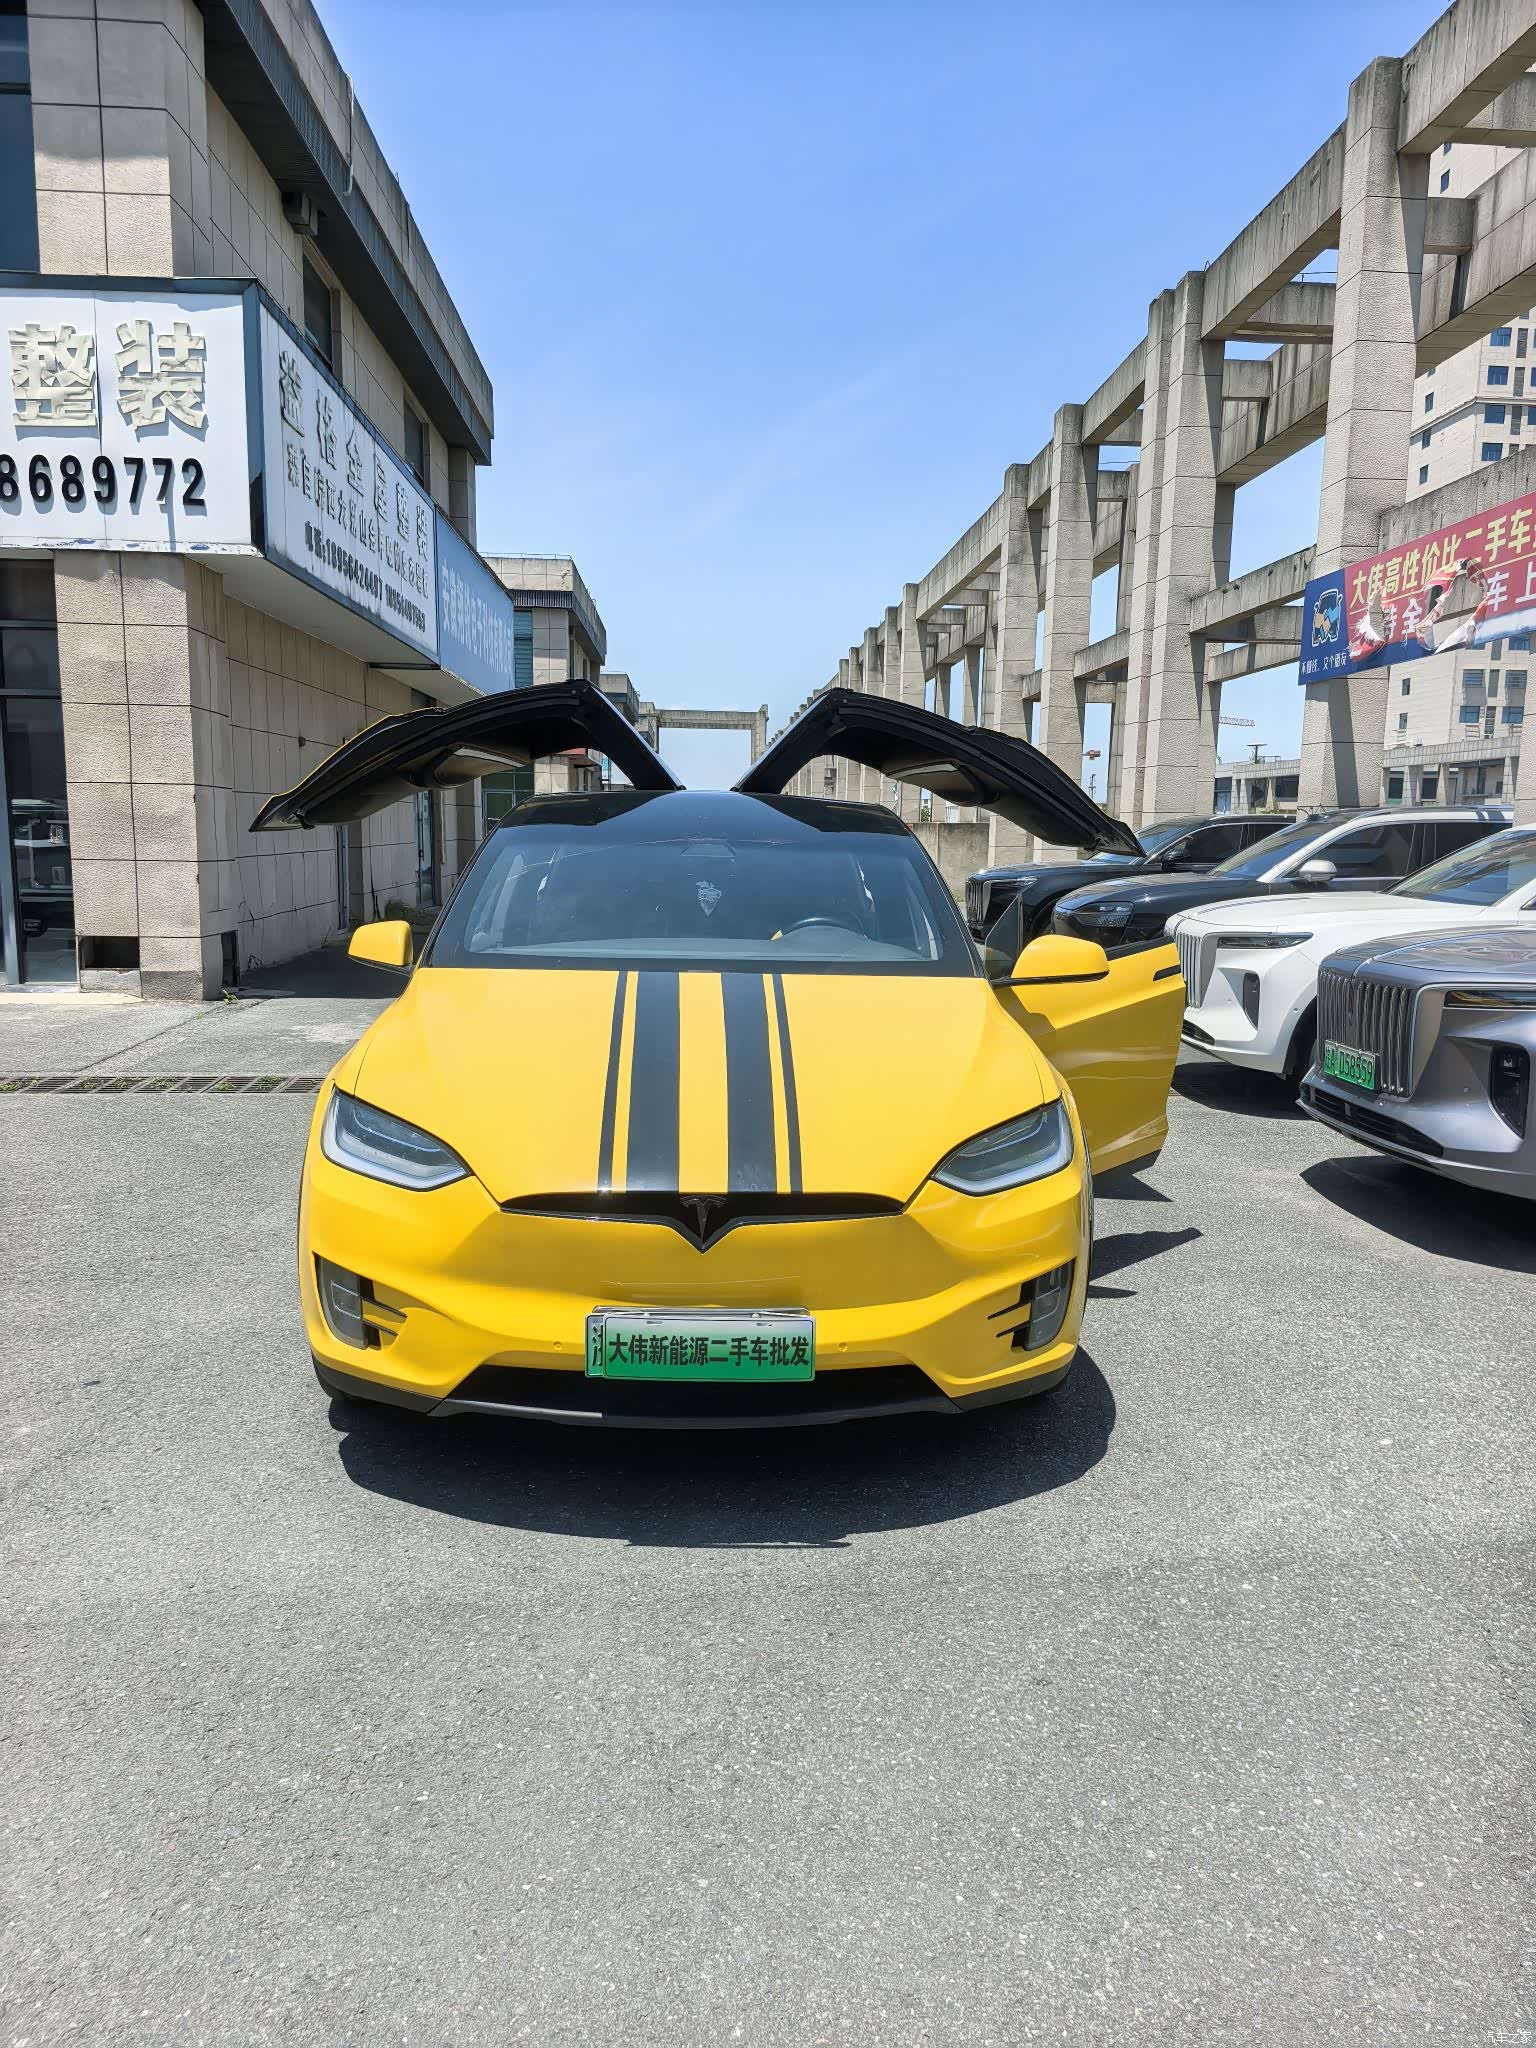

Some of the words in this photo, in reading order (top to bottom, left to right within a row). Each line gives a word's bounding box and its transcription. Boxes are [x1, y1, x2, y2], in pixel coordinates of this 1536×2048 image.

[1350, 508, 1536, 609] 大伟高性价比二手车
[608, 1333, 810, 1368] 大伟新能源二手车批发
